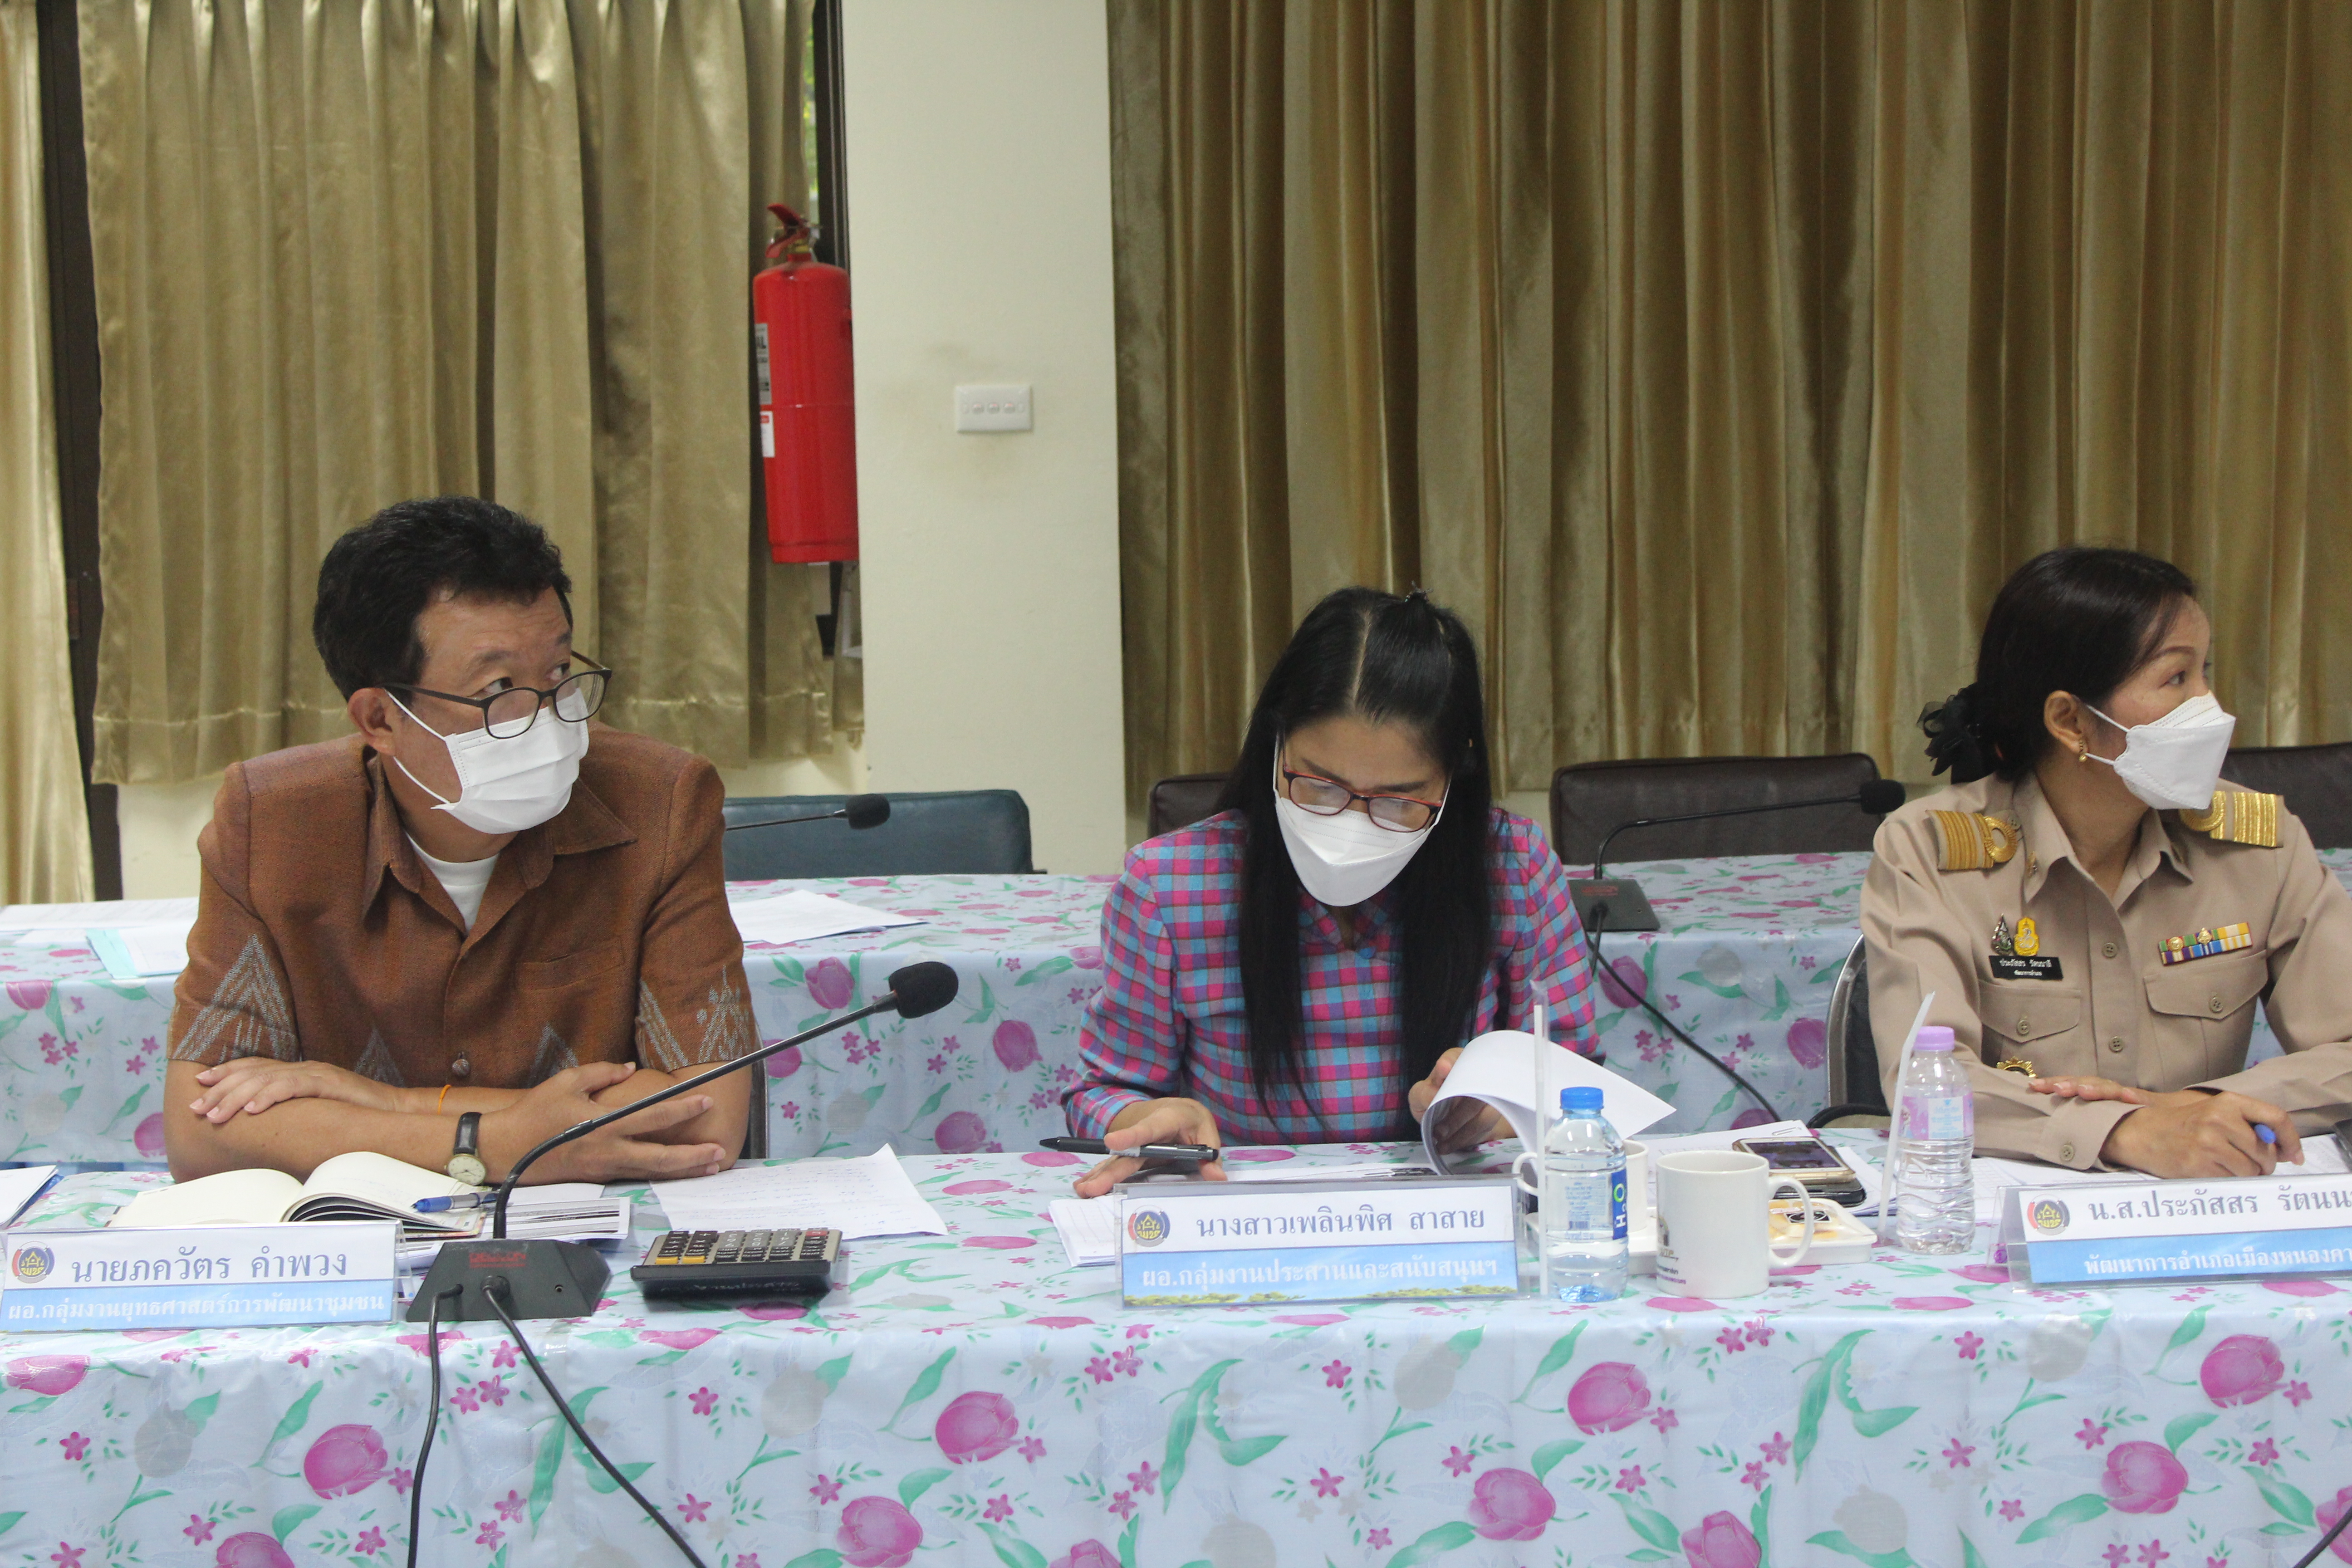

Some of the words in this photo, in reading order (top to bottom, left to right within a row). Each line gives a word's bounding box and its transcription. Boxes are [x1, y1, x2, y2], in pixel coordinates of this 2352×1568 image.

[1196, 1203, 1392, 1237] นางสาวเพลินพิศ
[1409, 1209, 1485, 1230] สาสาย
[2087, 1188, 2259, 1220] น.ส.ประภัสสร
[72, 1245, 231, 1283] นายภควัตร
[251, 1245, 347, 1278] คำพวง
